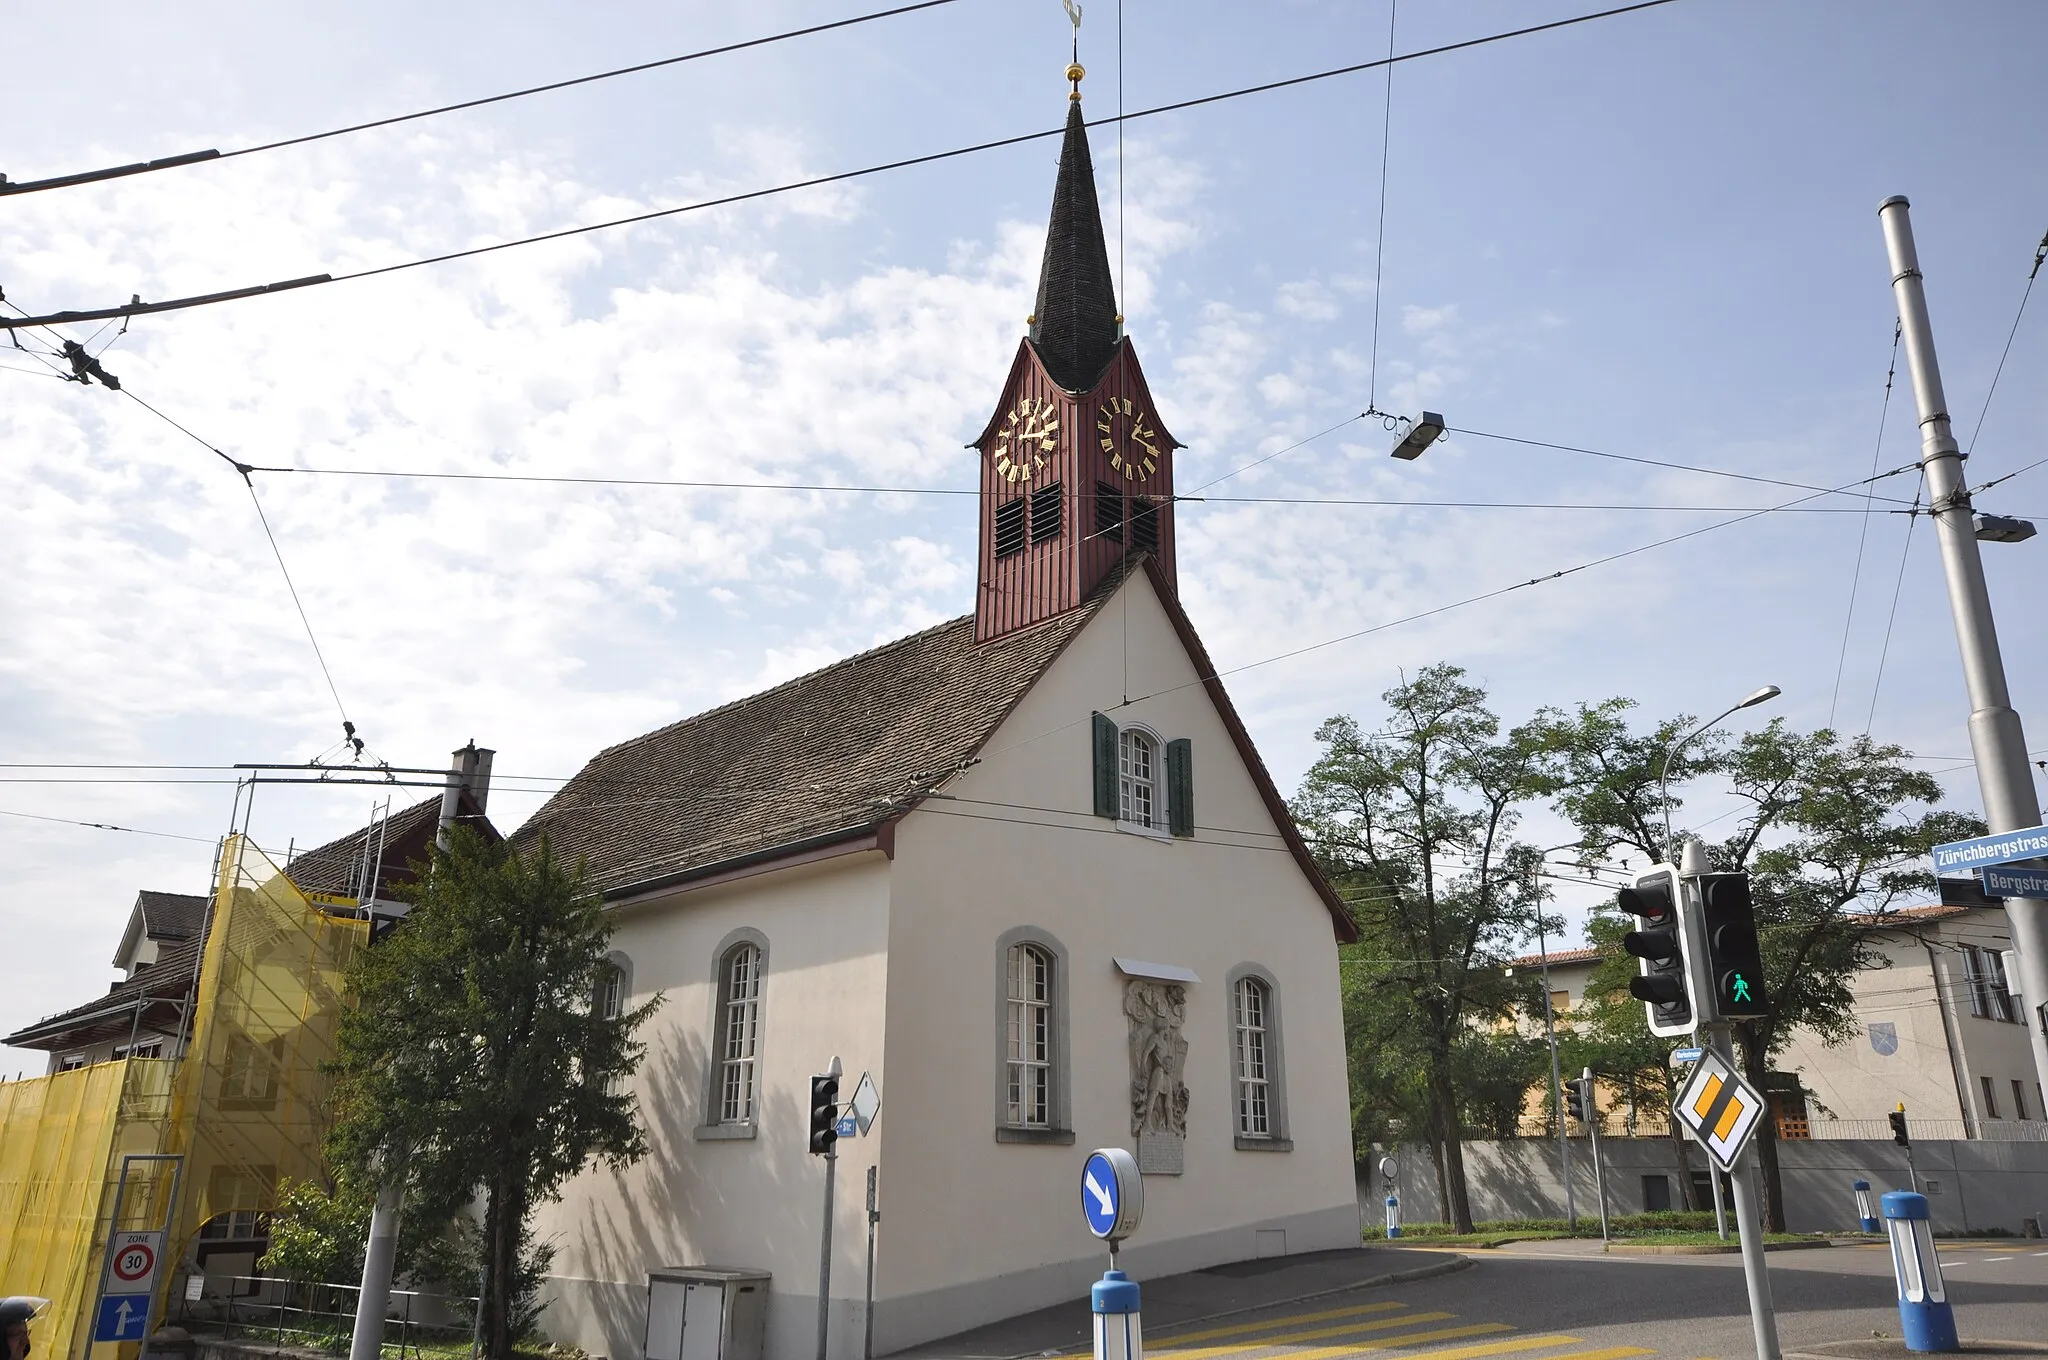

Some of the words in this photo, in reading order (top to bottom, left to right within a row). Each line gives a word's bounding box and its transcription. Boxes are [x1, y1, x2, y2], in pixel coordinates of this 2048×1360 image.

[1937, 836, 2048, 866] Zürichbergstras
[127, 1235, 149, 1243] ZONE
[126, 1256, 142, 1269] 30
